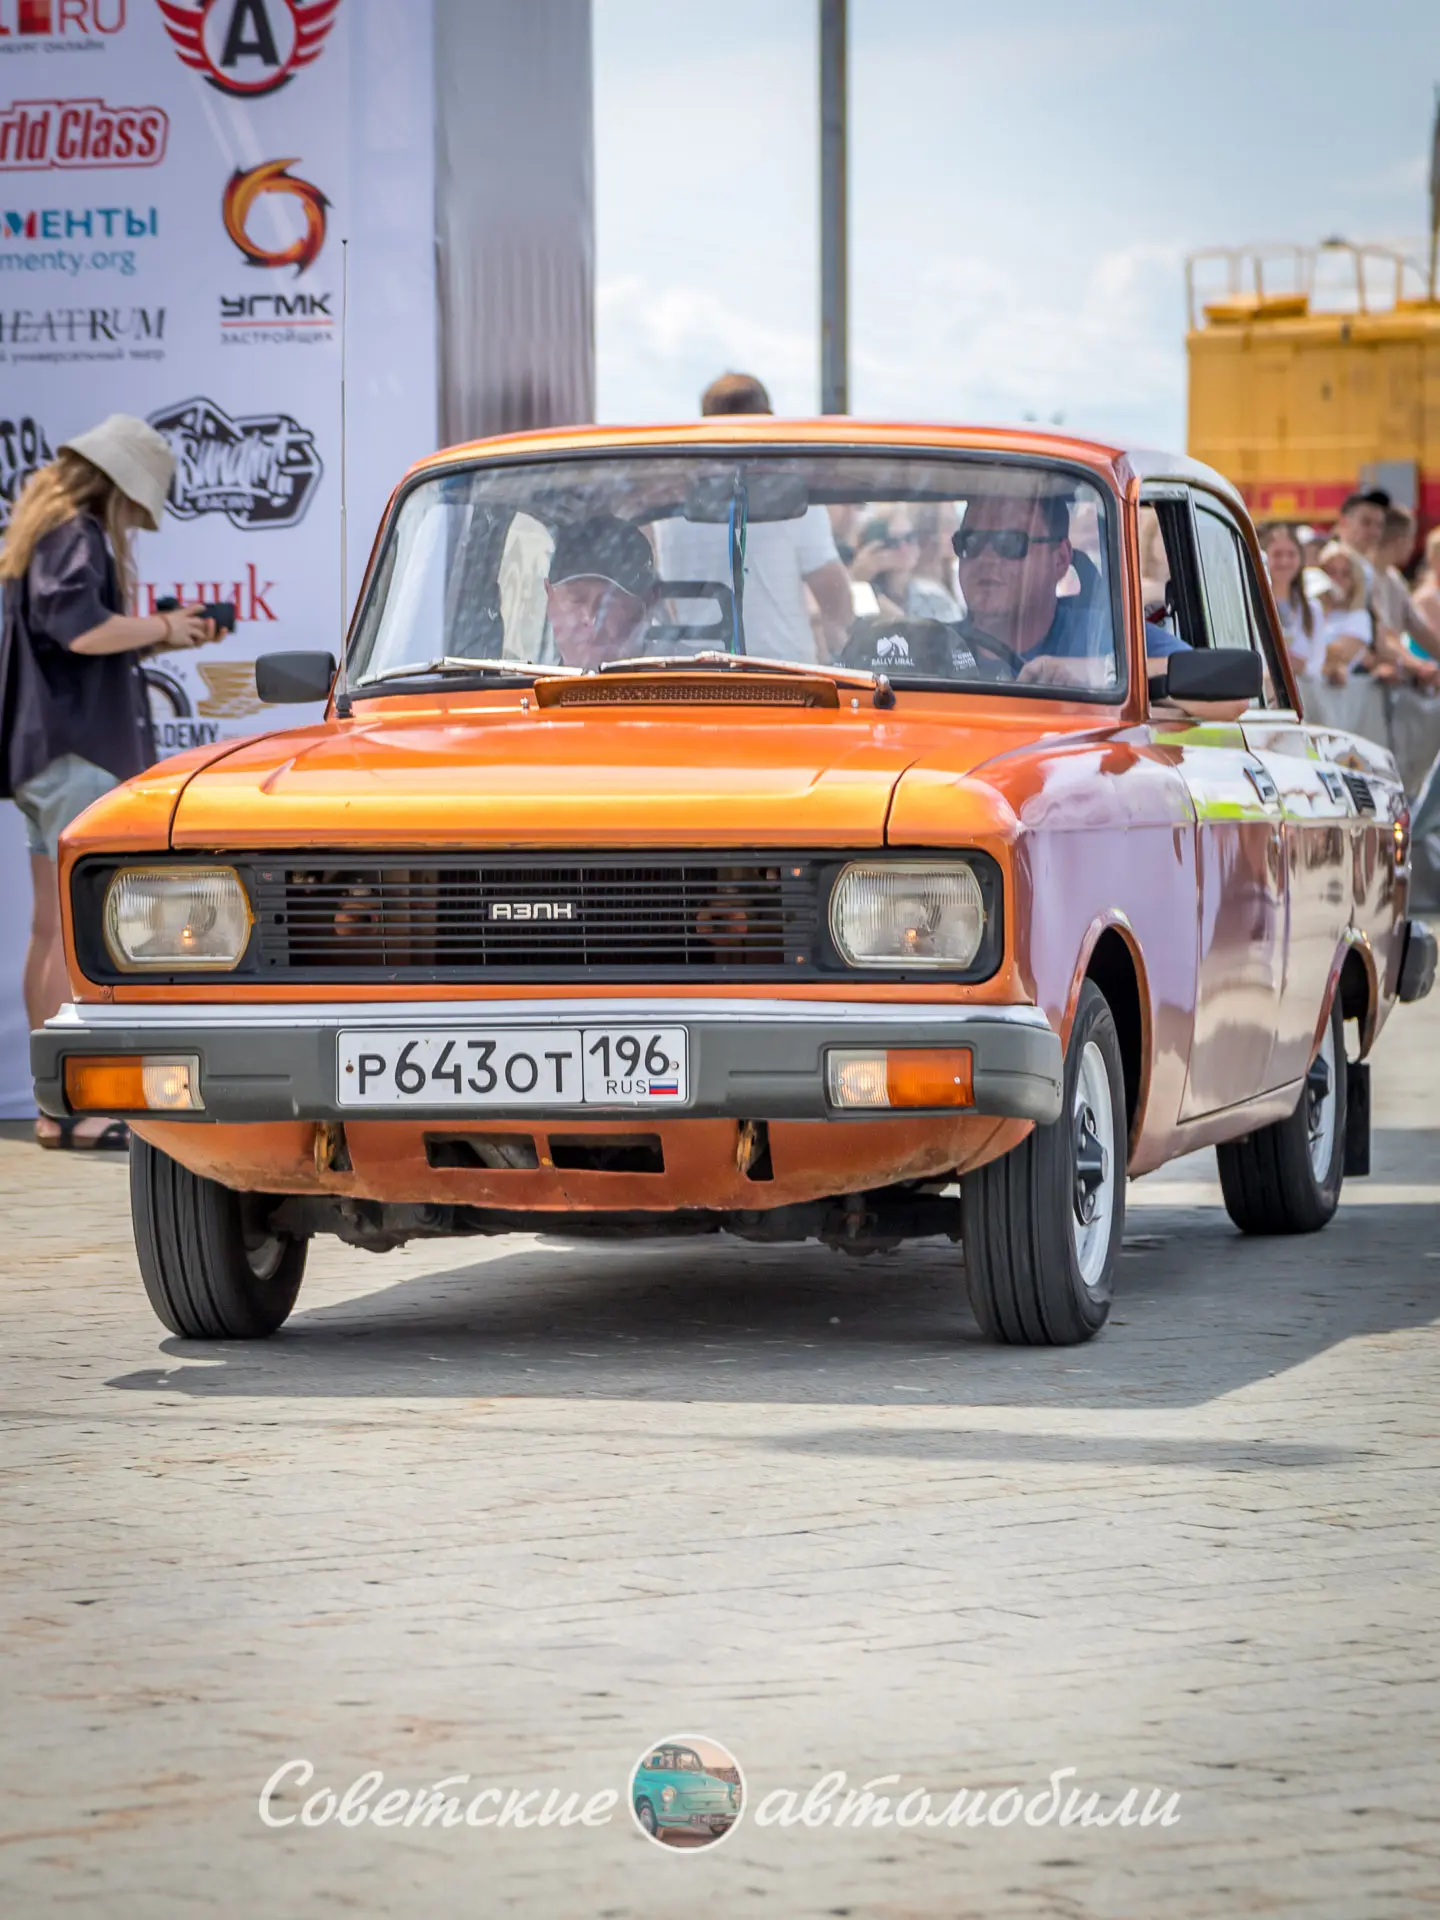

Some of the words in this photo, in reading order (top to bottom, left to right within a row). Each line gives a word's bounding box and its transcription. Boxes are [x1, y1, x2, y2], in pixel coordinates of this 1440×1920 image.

[57, 109, 159, 159] Class
[0, 207, 157, 239] МЕНТЫ
[220, 293, 332, 317] УГМК
[0, 306, 166, 343] EATRUM
[588, 1034, 670, 1077] 196
[606, 1079, 646, 1095] RUS
